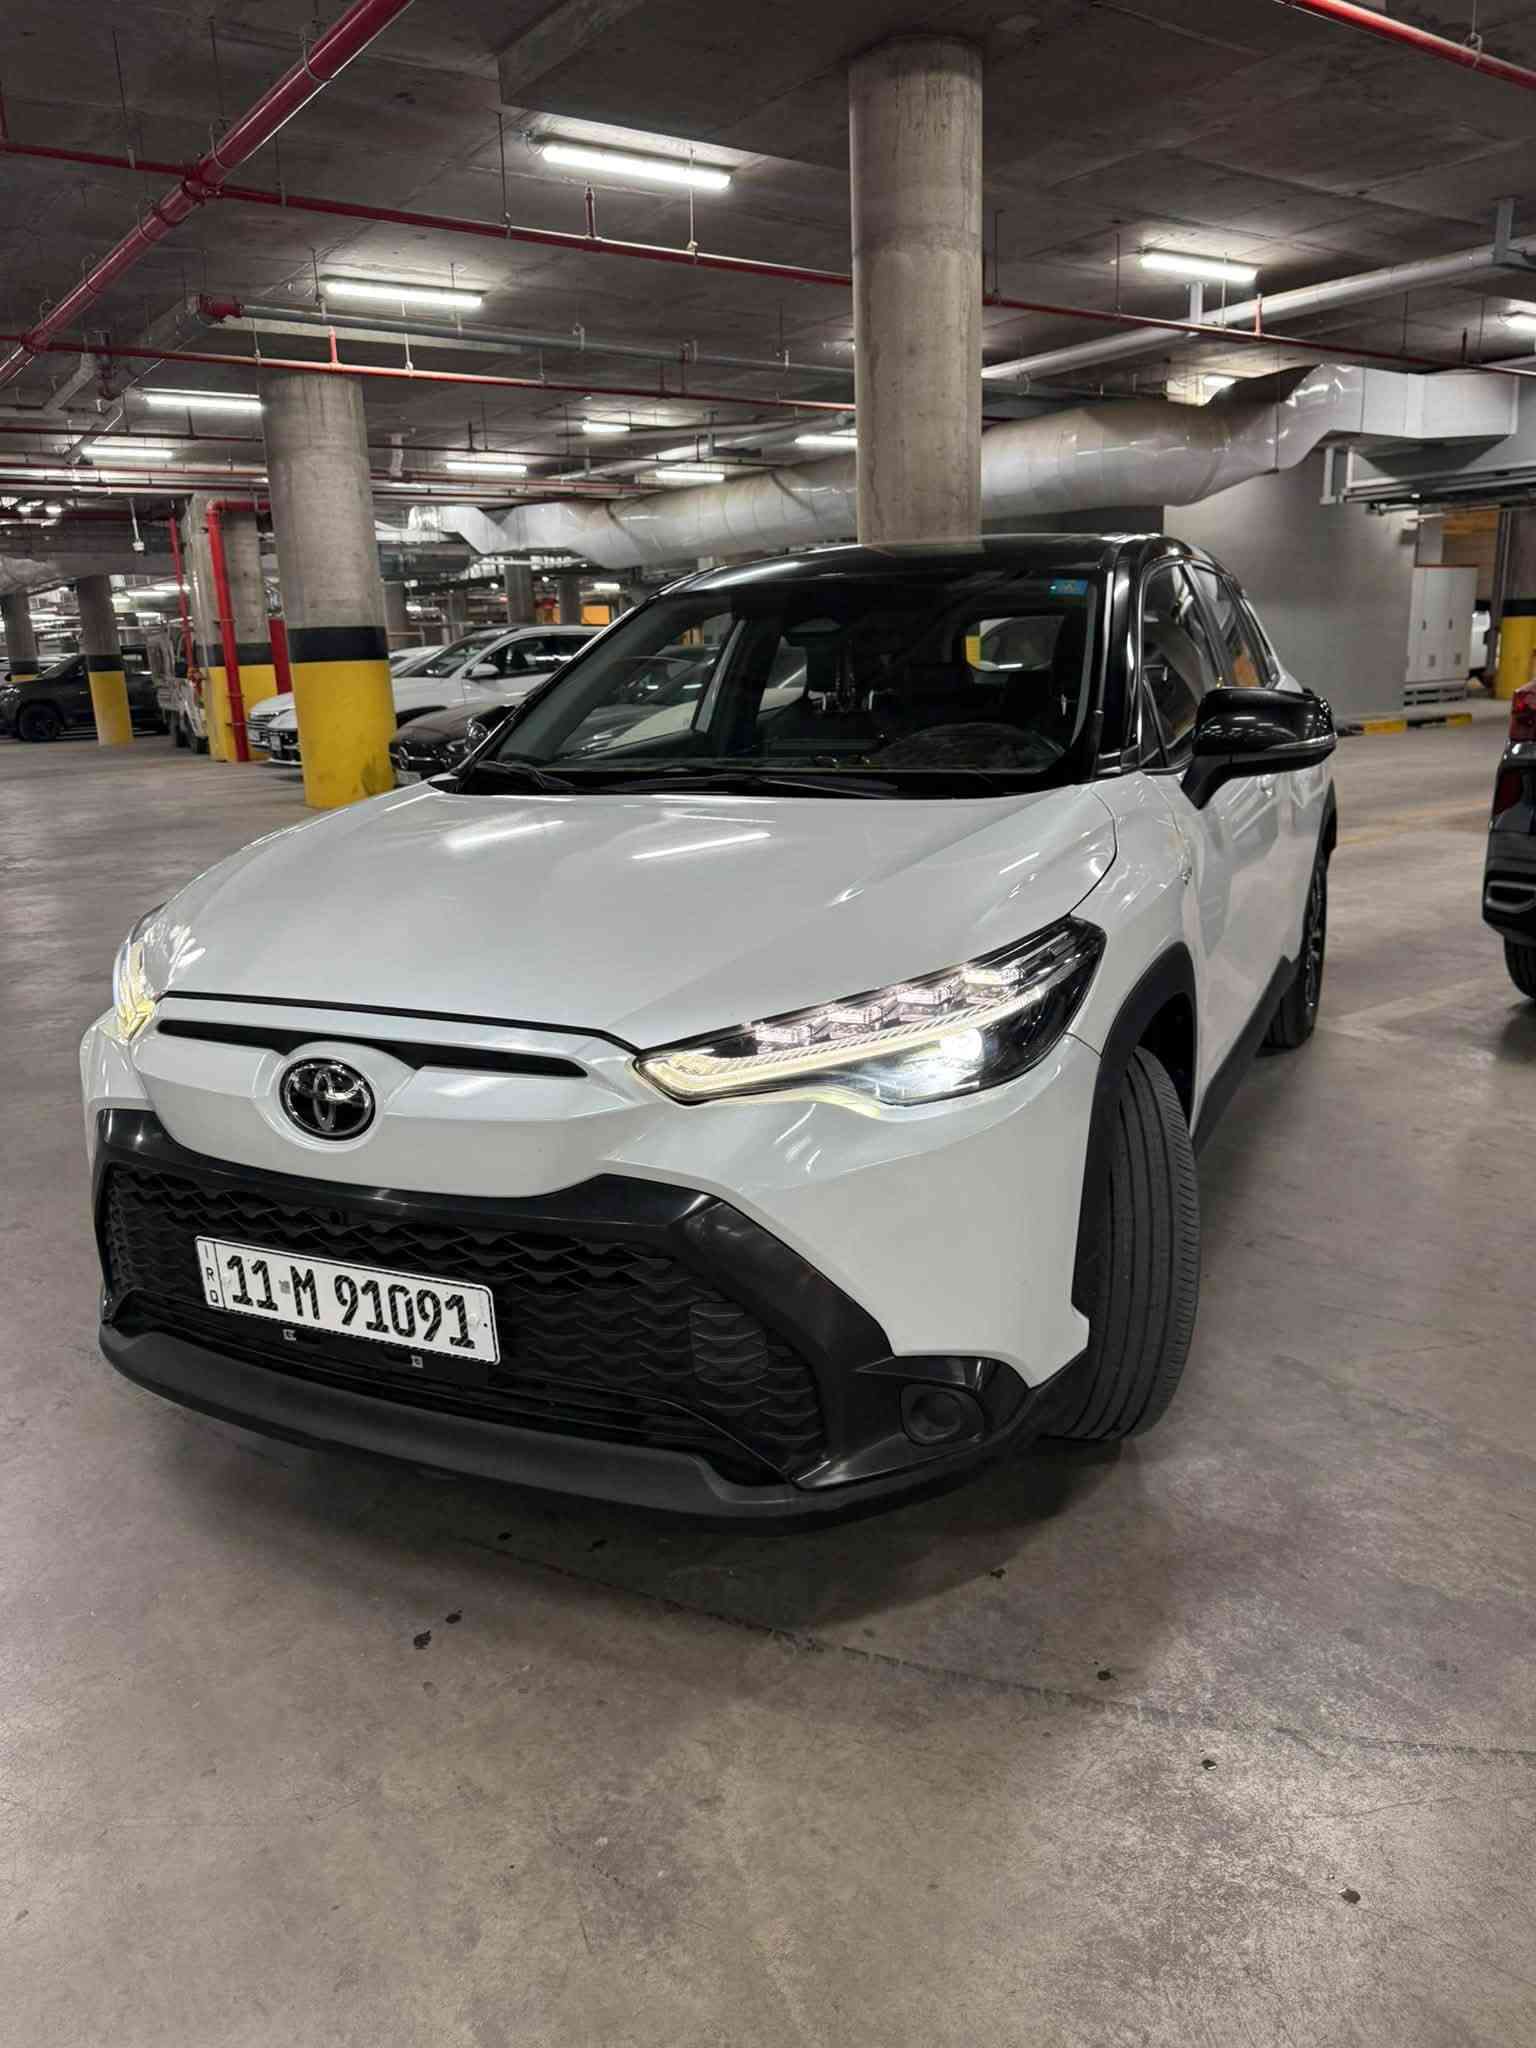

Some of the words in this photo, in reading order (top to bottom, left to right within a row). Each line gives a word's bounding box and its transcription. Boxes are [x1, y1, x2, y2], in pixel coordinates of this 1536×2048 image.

[227, 1255, 278, 1311] 11
[290, 1265, 320, 1320] M
[334, 1274, 475, 1349] 91091
